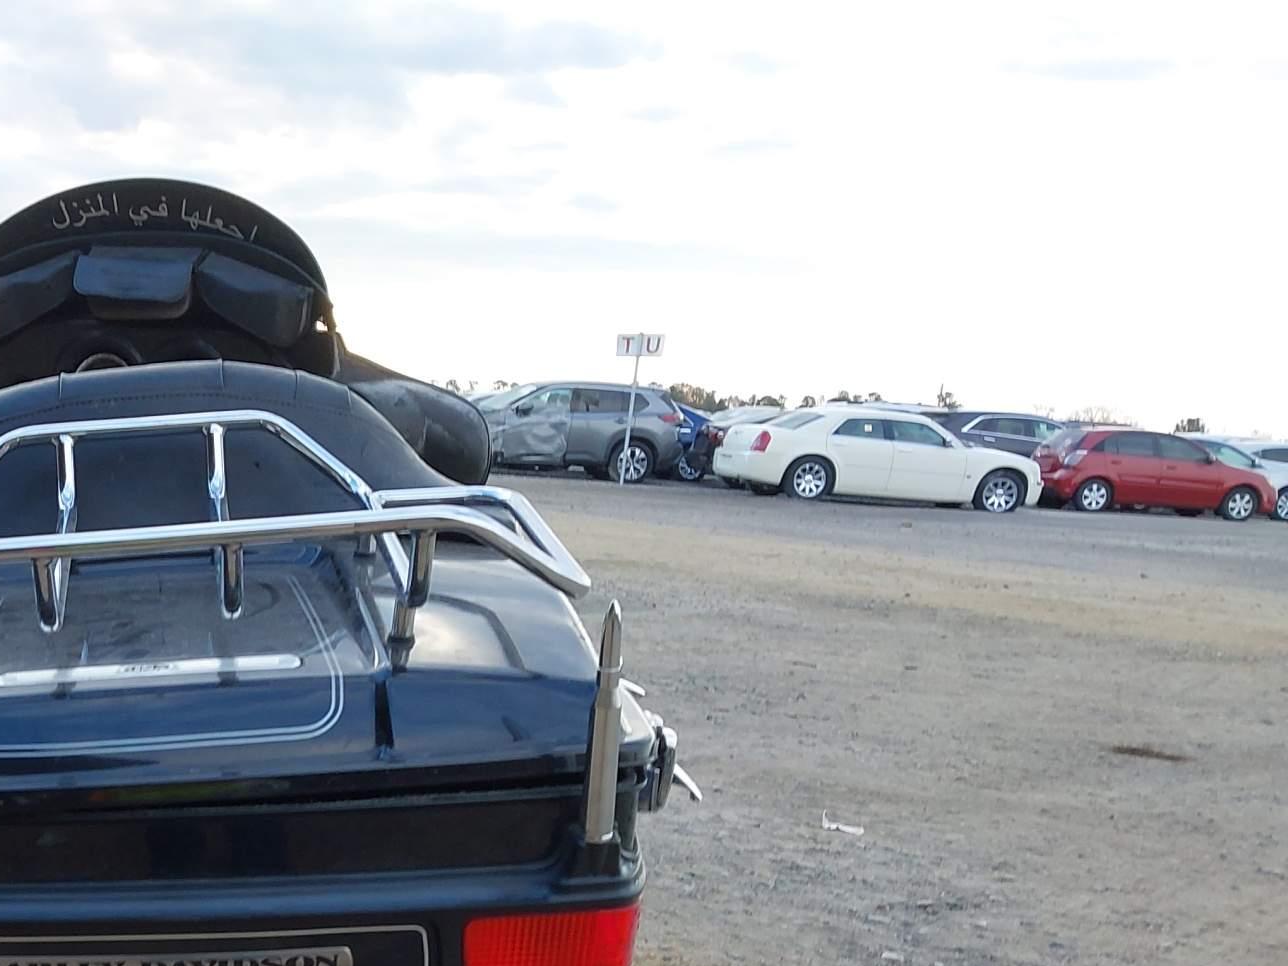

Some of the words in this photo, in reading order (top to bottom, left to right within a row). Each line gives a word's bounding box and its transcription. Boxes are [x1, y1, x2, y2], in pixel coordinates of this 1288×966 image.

[52, 192, 119, 229] المنزل
[129, 195, 169, 226] في
[622, 336, 635, 354] T
[646, 336, 661, 354] U
